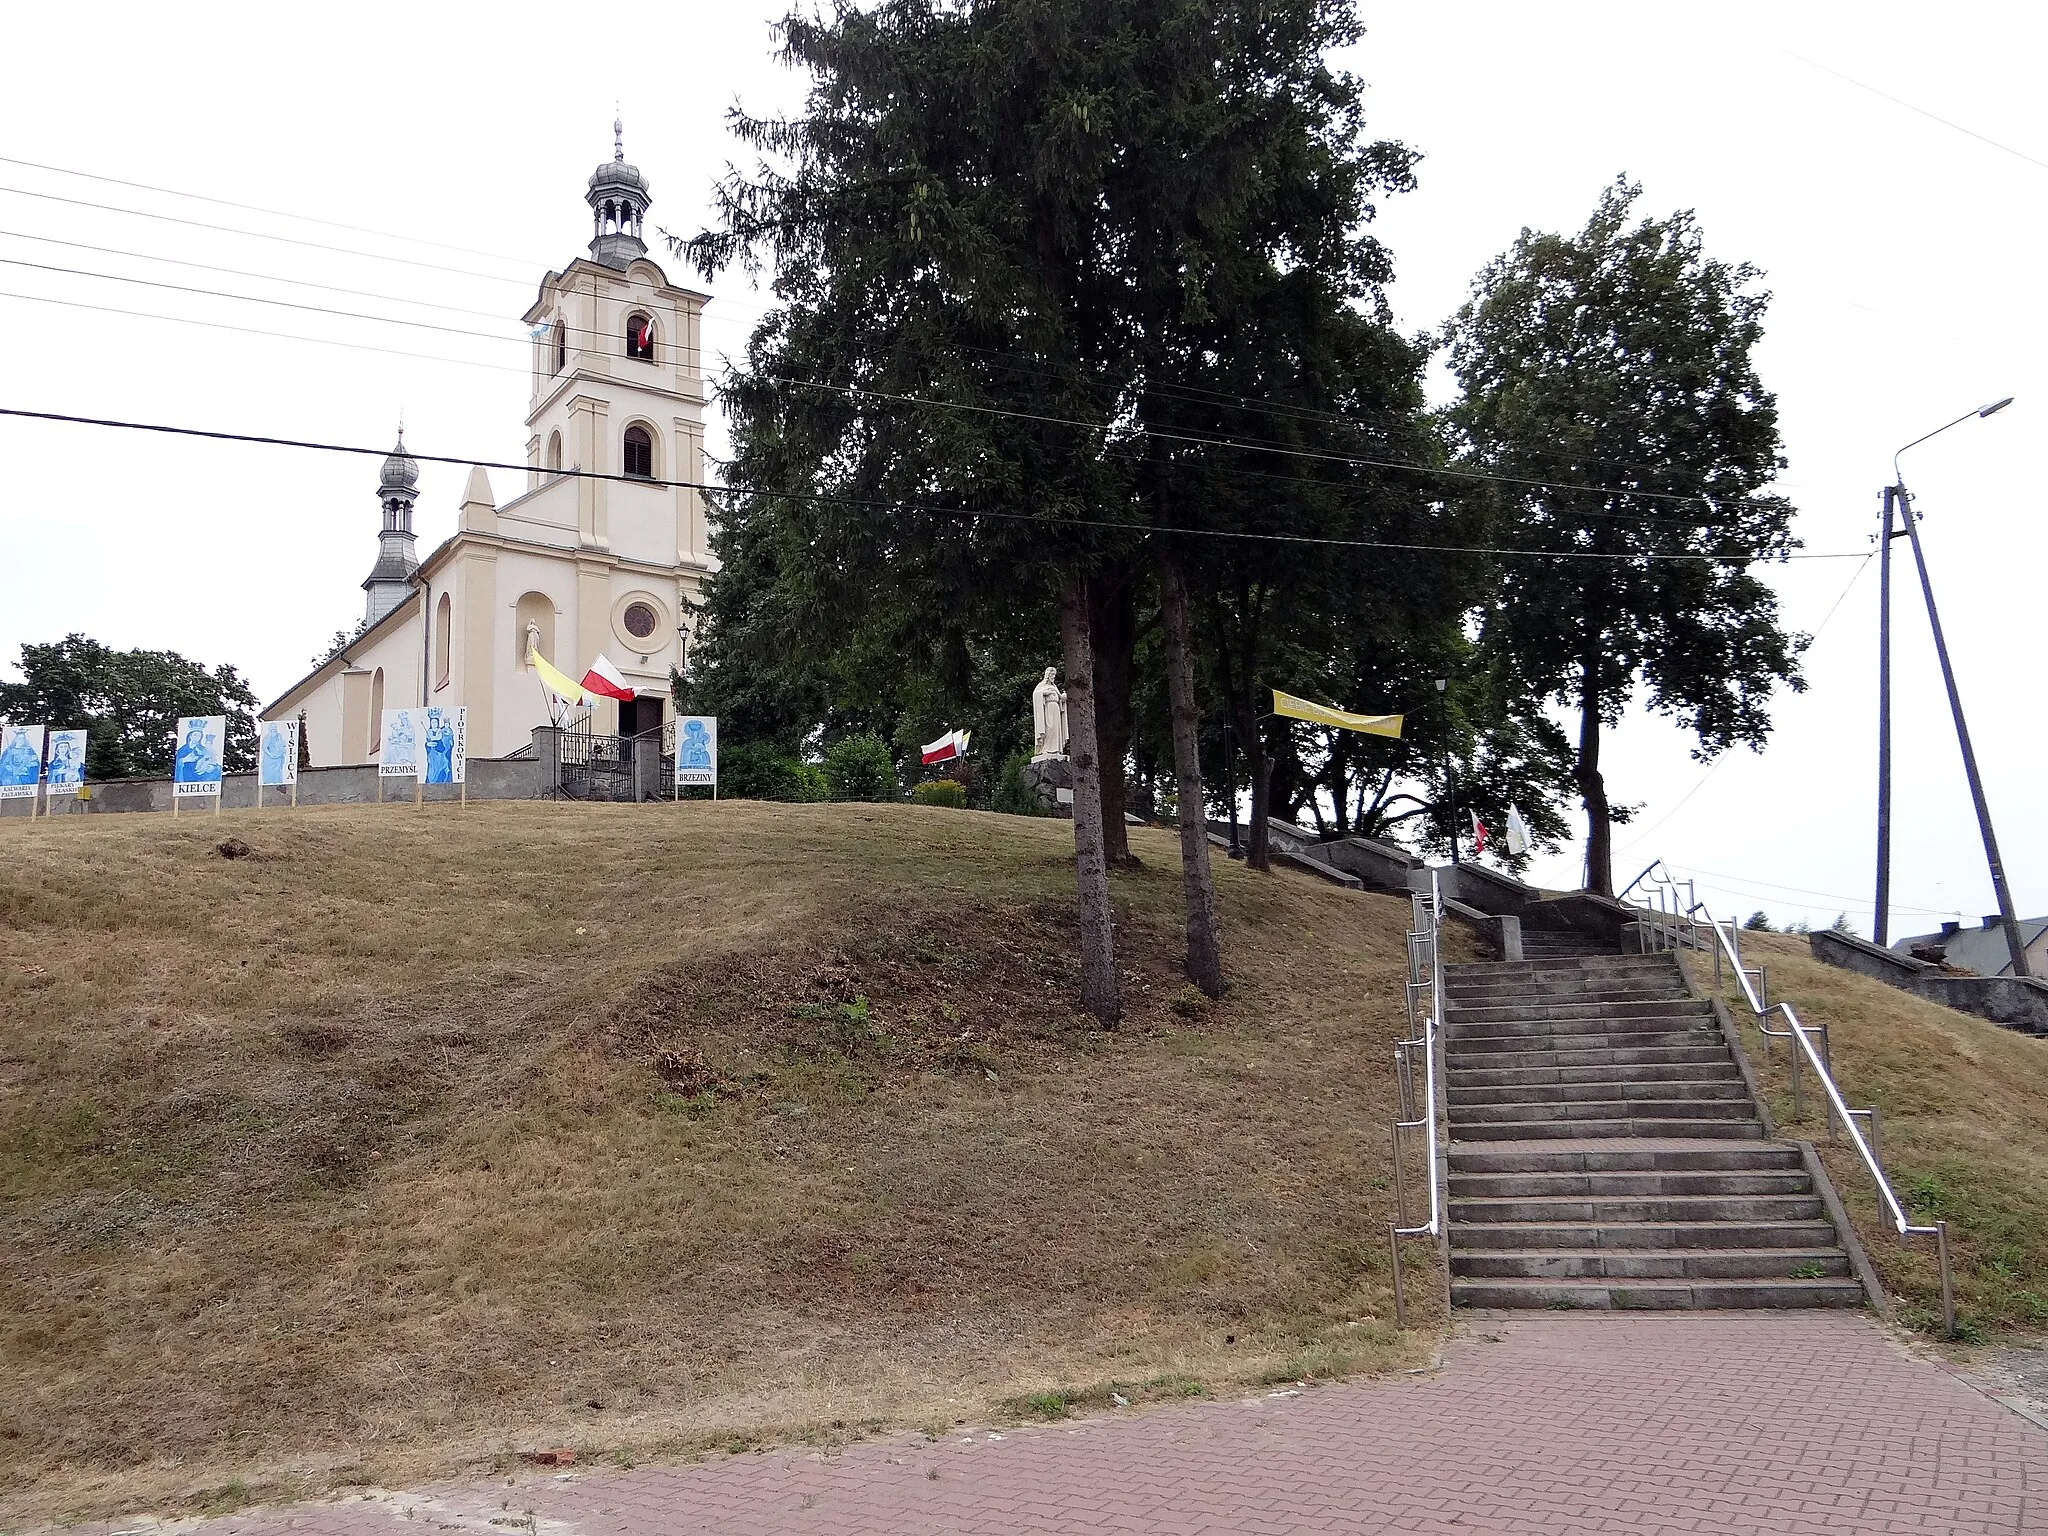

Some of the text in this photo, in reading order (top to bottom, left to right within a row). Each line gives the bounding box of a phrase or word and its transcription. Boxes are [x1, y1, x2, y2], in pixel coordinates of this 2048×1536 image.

[456, 708, 466, 780] PIOTRKOWICE
[381, 764, 418, 774] PRZEMYŚL
[679, 773, 712, 782] BRZEZINY
[178, 783, 217, 793] KIELCE
